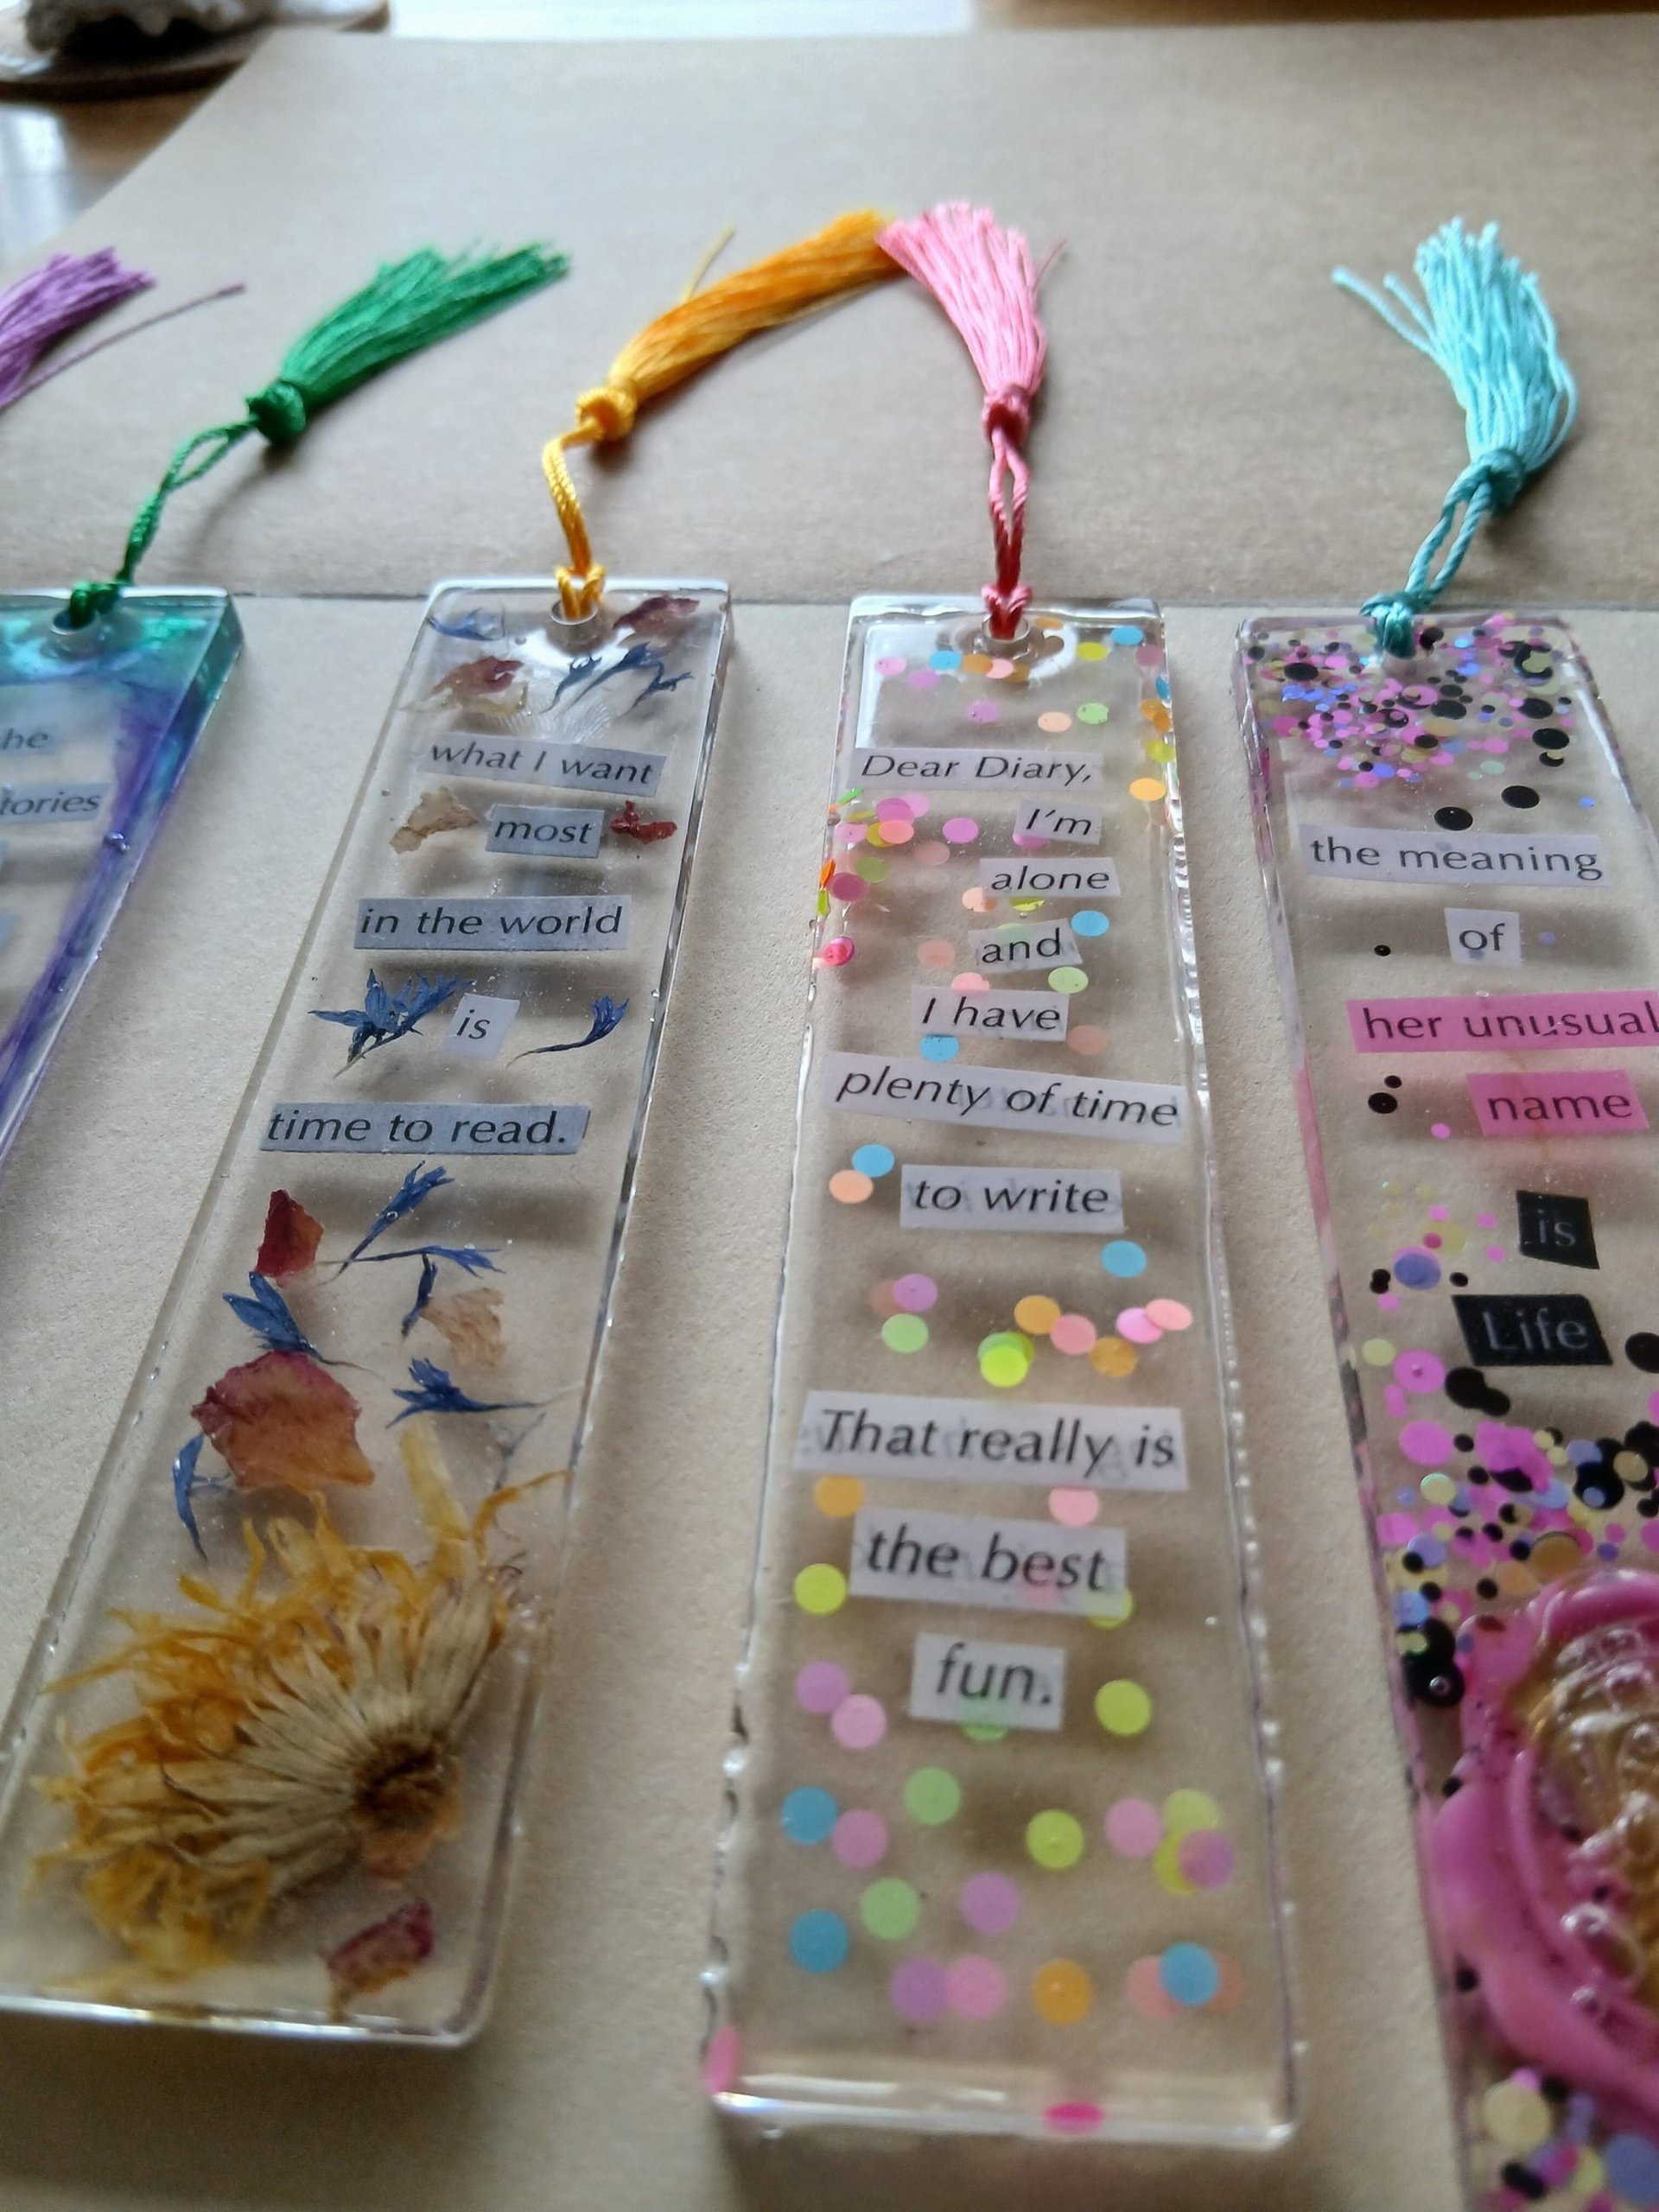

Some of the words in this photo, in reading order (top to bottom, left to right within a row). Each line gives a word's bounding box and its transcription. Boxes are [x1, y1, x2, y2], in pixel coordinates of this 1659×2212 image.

[431, 741, 524, 772] what
[533, 751, 549, 772] I
[562, 758, 654, 785] want
[861, 754, 960, 778] Dear
[975, 756, 1092, 786] Diary,
[493, 819, 593, 844] most
[1025, 808, 1092, 836] I'm
[1310, 836, 1381, 866] the
[1399, 847, 1603, 881] meaning
[990, 865, 1111, 891] alone
[359, 908, 399, 934] in
[416, 906, 483, 934] the
[499, 906, 623, 934] world
[1459, 923, 1506, 951] of
[981, 927, 1062, 963] and
[456, 1009, 491, 1039] is
[922, 997, 937, 1025] I
[952, 996, 1062, 1030] have
[1363, 1007, 1443, 1039] her
[1464, 1000, 1659, 1039] unusual
[836, 1065, 991, 1116] plenty
[1006, 1082, 1062, 1115] of
[1071, 1090, 1179, 1126] time
[1487, 1093, 1632, 1121] name
[267, 1109, 372, 1141] time
[389, 1115, 432, 1142] to
[450, 1110, 567, 1144] read.
[914, 1180, 962, 1210] to
[983, 1179, 1109, 1212] write
[1537, 1208, 1576, 1248] is
[1482, 1307, 1589, 1351] Life
[822, 1408, 938, 1458] That
[957, 1417, 1115, 1478] really
[1135, 1425, 1175, 1468] is
[868, 1522, 961, 1580] the
[981, 1532, 1107, 1592] best
[936, 1642, 1053, 1706] fun.
